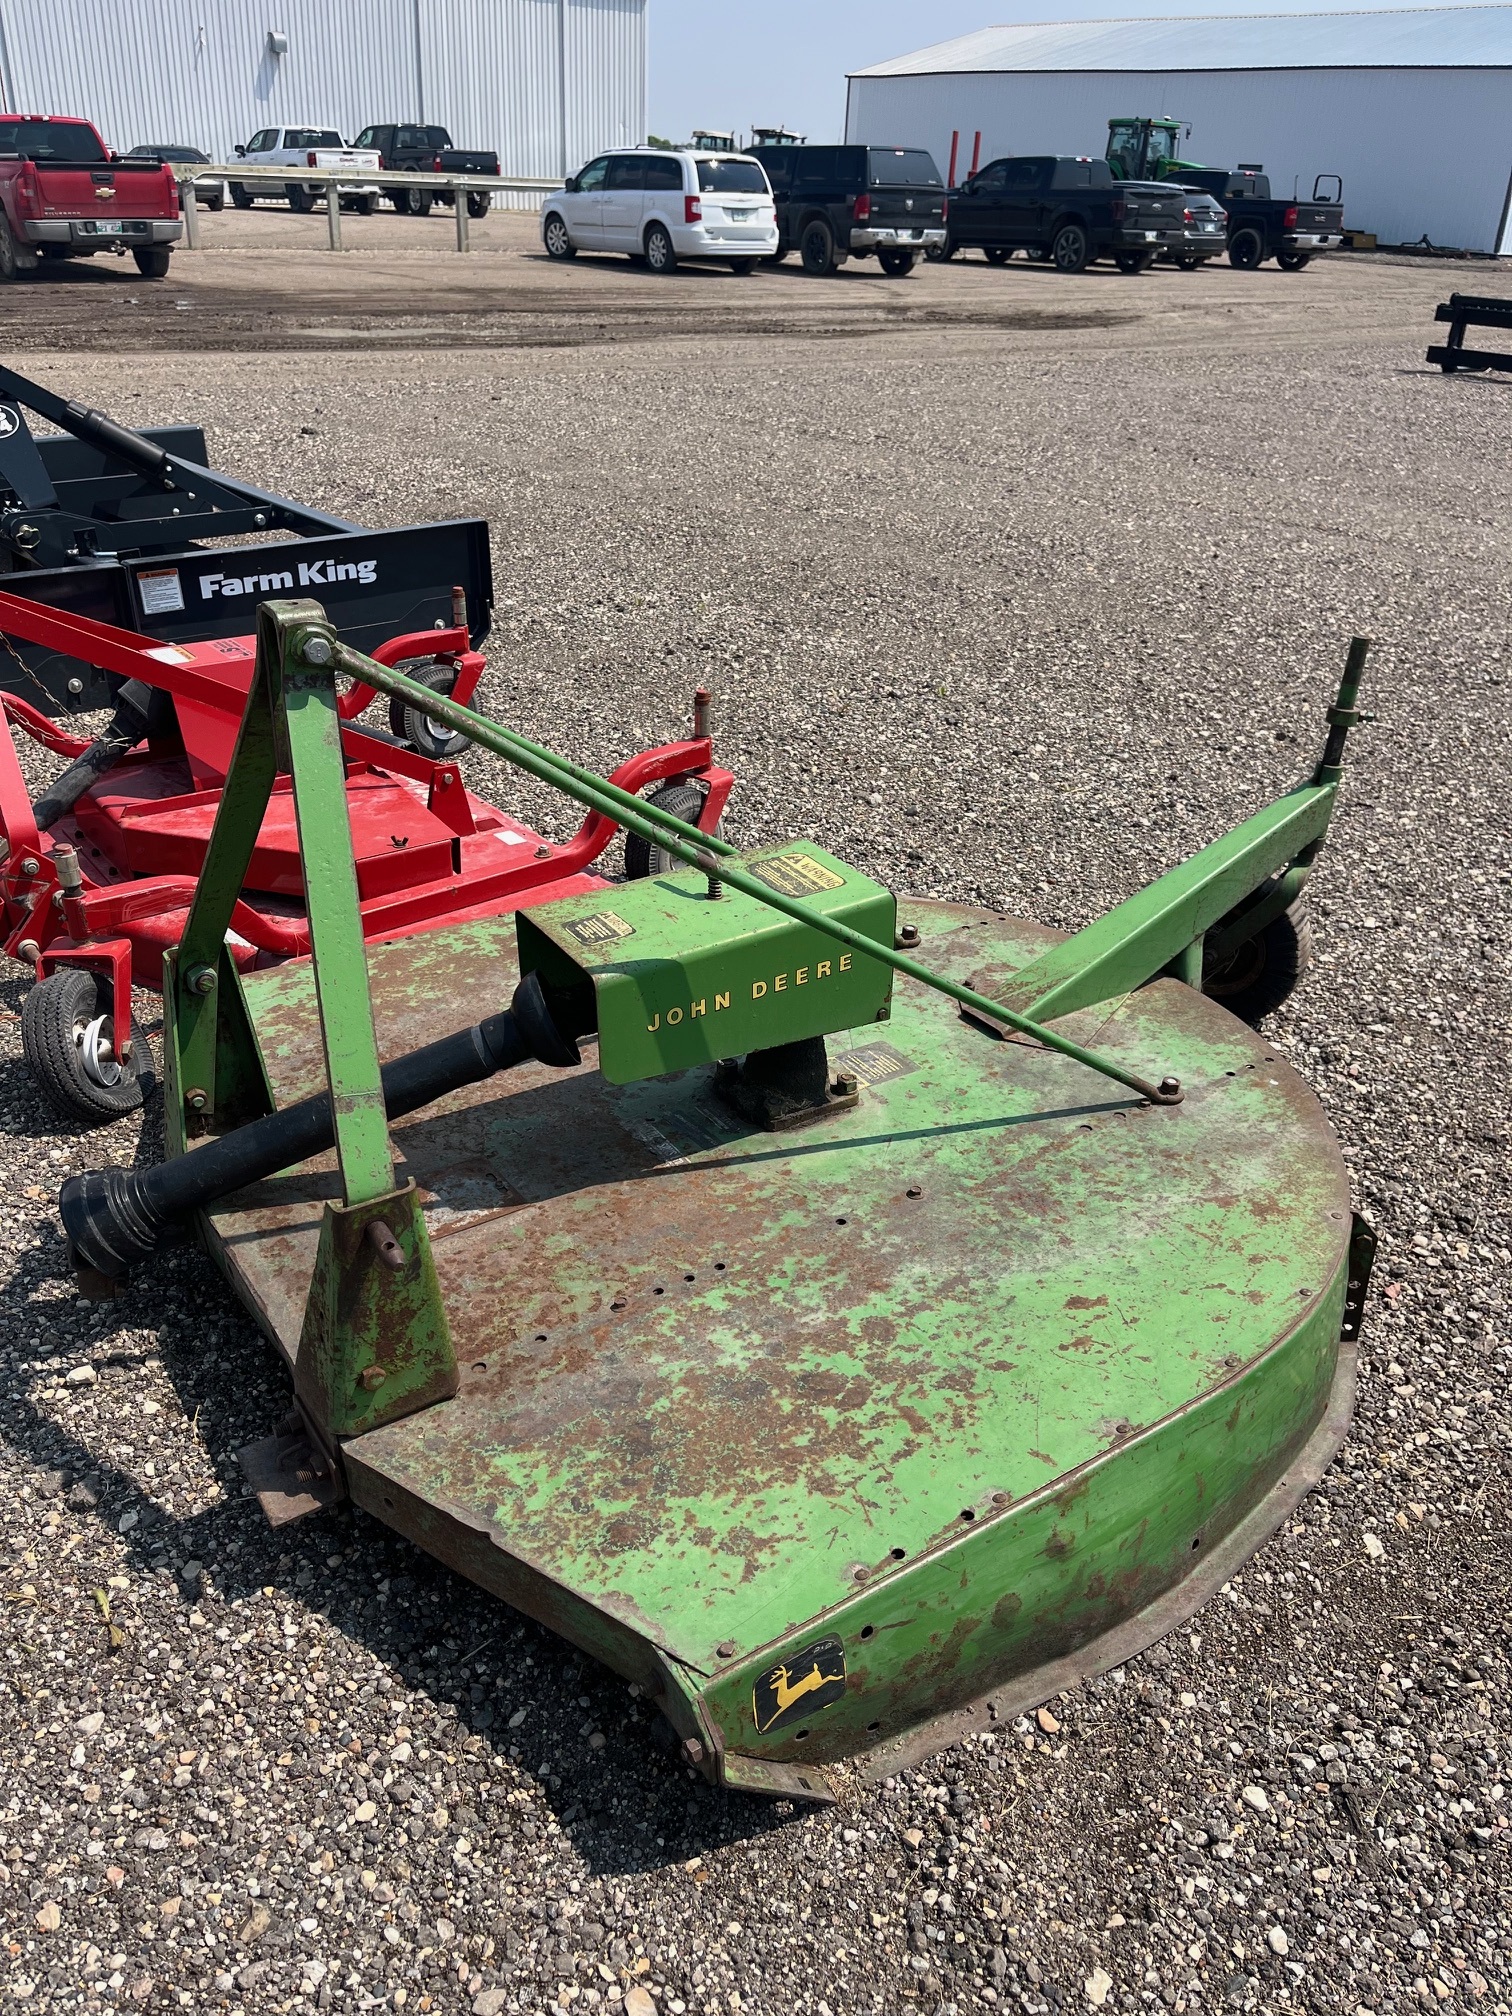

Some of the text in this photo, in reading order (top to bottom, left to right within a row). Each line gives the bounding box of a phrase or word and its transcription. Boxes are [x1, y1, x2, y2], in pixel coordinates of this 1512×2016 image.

[199, 571, 294, 600] Farm
[298, 559, 378, 584] King
[801, 862, 841, 888] WARNING
[647, 953, 853, 1032] JOHN DEERE
